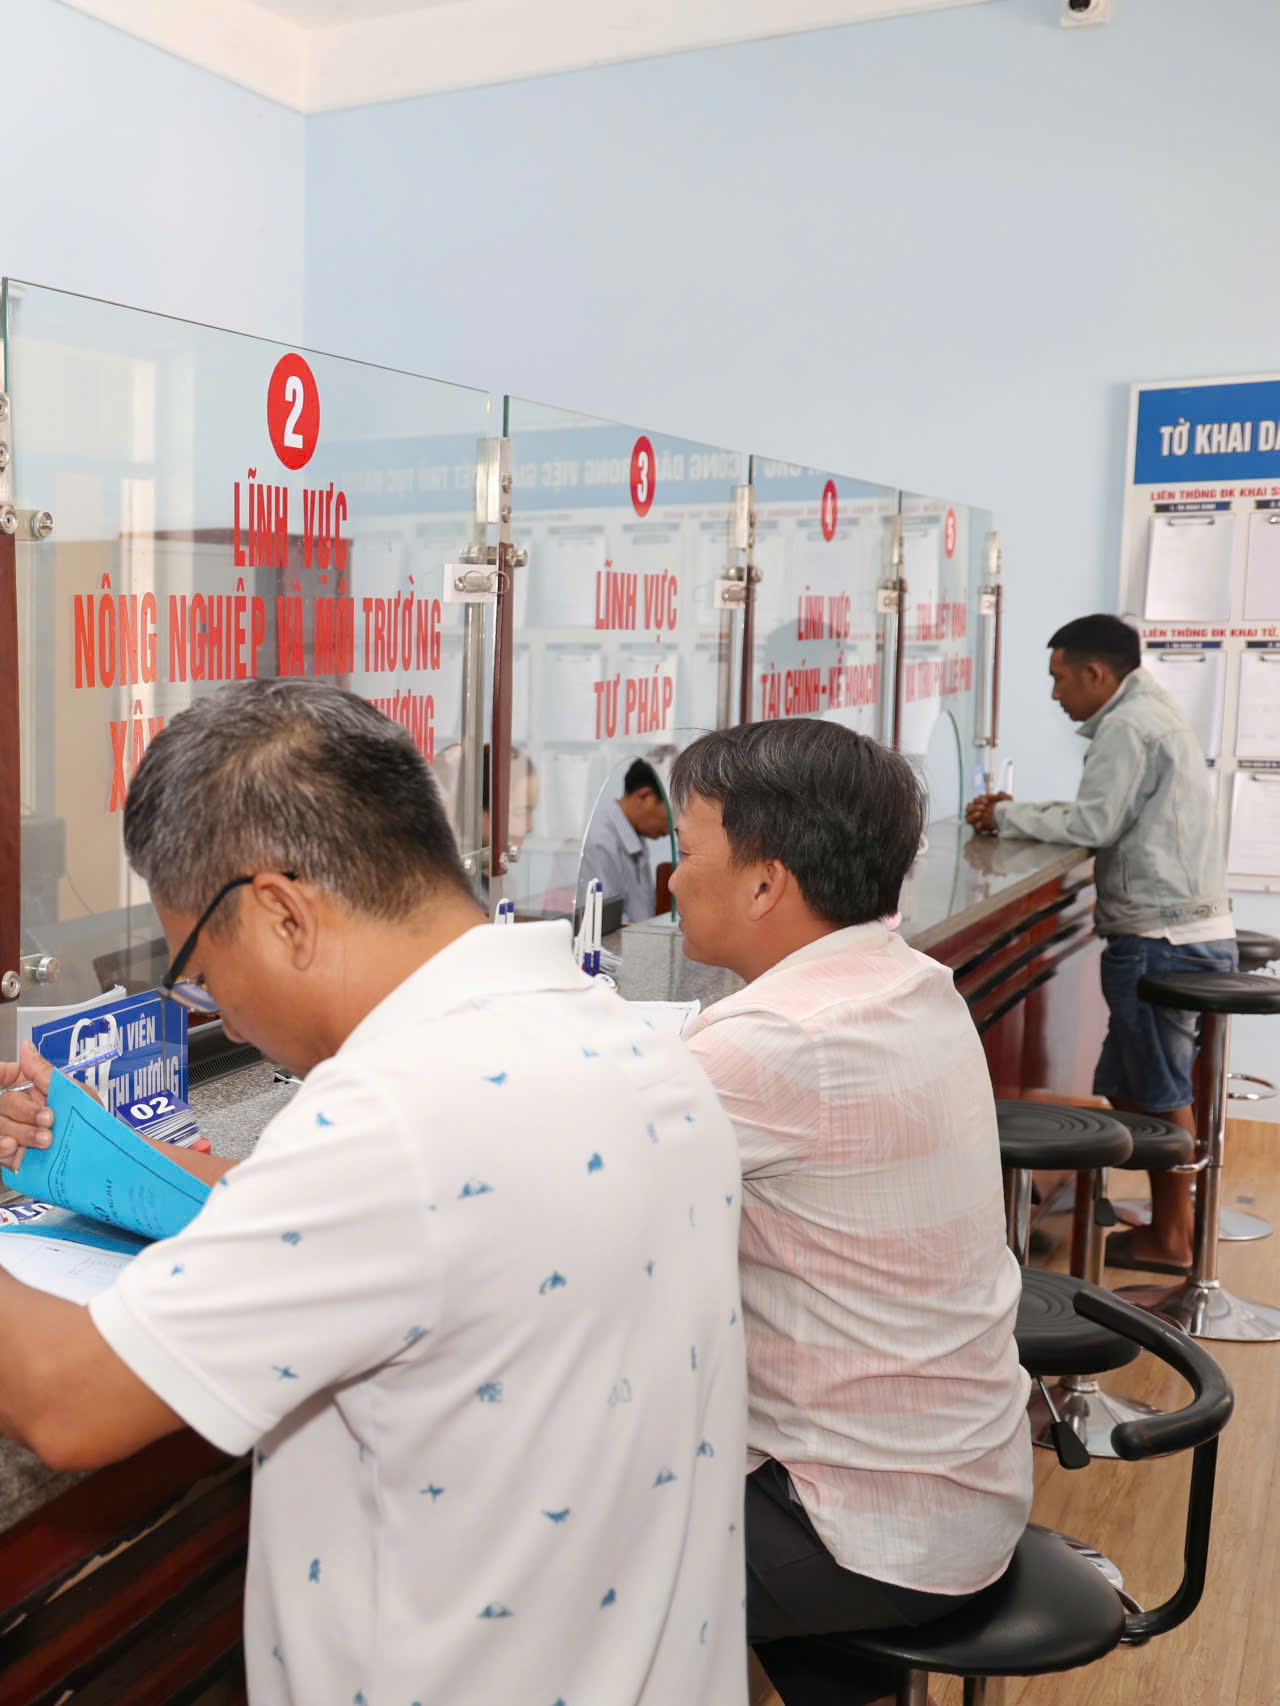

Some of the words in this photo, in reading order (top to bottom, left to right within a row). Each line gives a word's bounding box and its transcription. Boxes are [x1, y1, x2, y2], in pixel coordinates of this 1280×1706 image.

[283, 376, 305, 449] 2
[1159, 417, 1191, 456] TỜ
[1195, 421, 1252, 455] KHAI
[1258, 420, 1280, 452] D
[637, 451, 649, 502] 3
[233, 467, 288, 567] LĨNH
[303, 482, 348, 585] VỰC
[74, 573, 157, 688] NÔNG
[169, 577, 266, 686] NGHIỆP
[277, 581, 305, 676] VÀ
[315, 579, 355, 675] MÔI
[363, 574, 441, 672] TRƯỜNG
[595, 560, 638, 630] LĨNH
[644, 568, 678, 644] VỰC
[594, 673, 621, 740] TƯ
[624, 664, 673, 736] PHÁP
[110, 699, 164, 812] XÂ
[126, 1013, 155, 1051] VIÊN
[130, 1096, 176, 1120] 02
